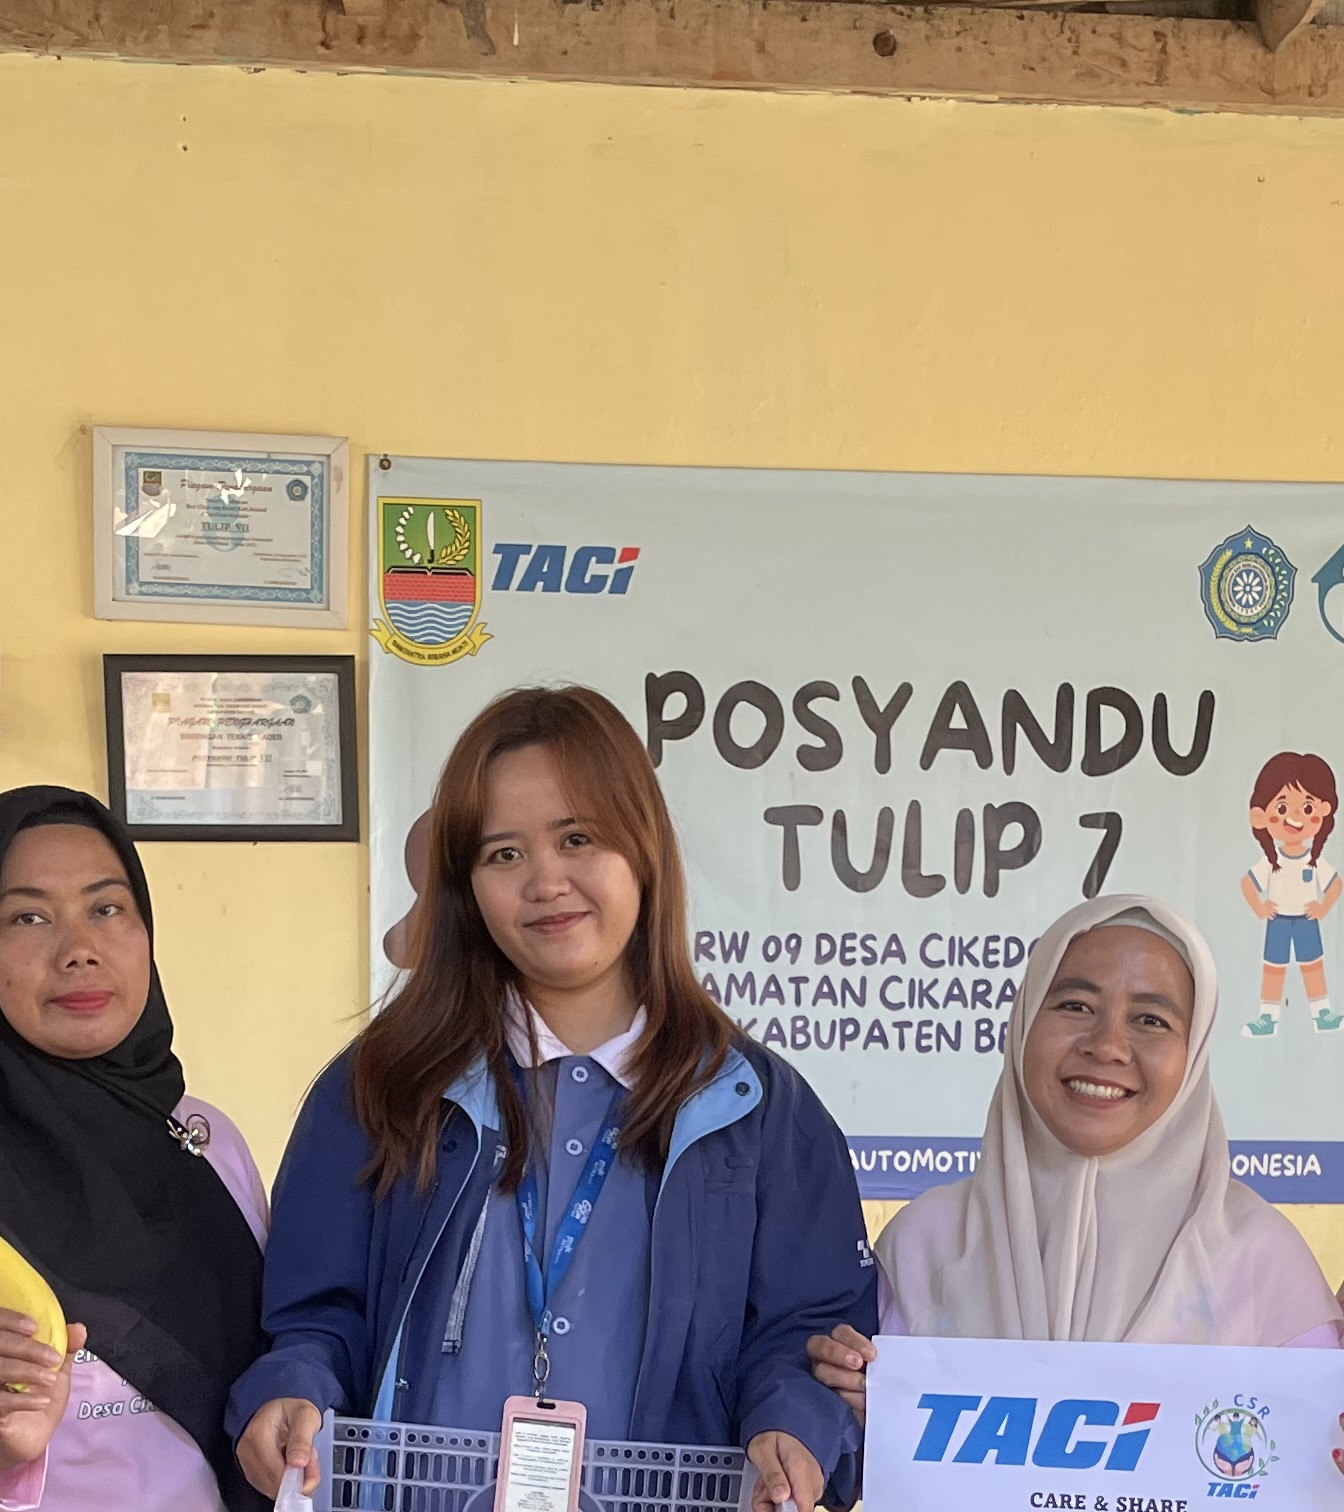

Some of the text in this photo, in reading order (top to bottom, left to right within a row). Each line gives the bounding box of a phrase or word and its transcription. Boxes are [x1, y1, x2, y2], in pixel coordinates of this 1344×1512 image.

[645, 670, 1216, 777] POSYANDU
[763, 799, 1123, 900] TULIP 7
[694, 930, 1040, 969] RW 09 DESA CIKED
[77, 1400, 125, 1420] Desa
[1232, 1393, 1271, 1421] CSR
[1029, 1491, 1087, 1510] CARE
[1093, 1495, 1108, 1512] &
